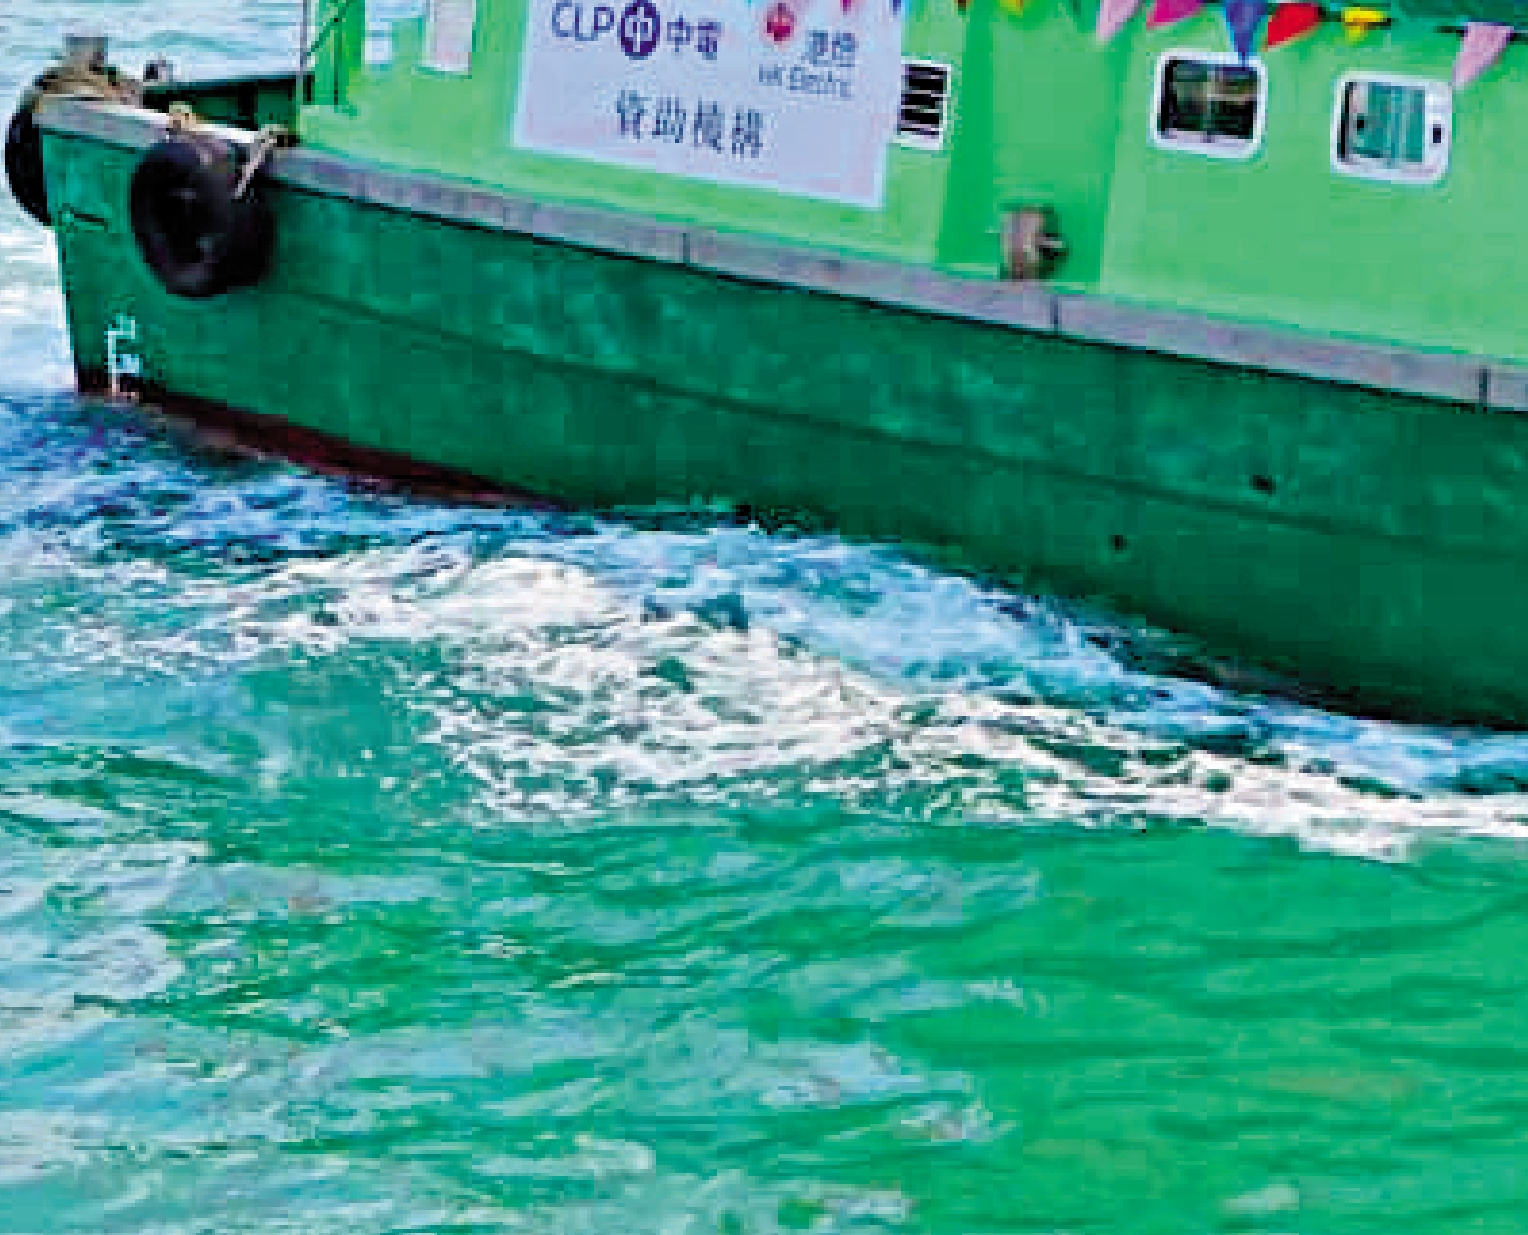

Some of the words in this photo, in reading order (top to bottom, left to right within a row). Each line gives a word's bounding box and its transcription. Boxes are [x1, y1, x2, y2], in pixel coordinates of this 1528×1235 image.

[757, 64, 785, 85] HK
[613, 88, 765, 160] 資助機構
